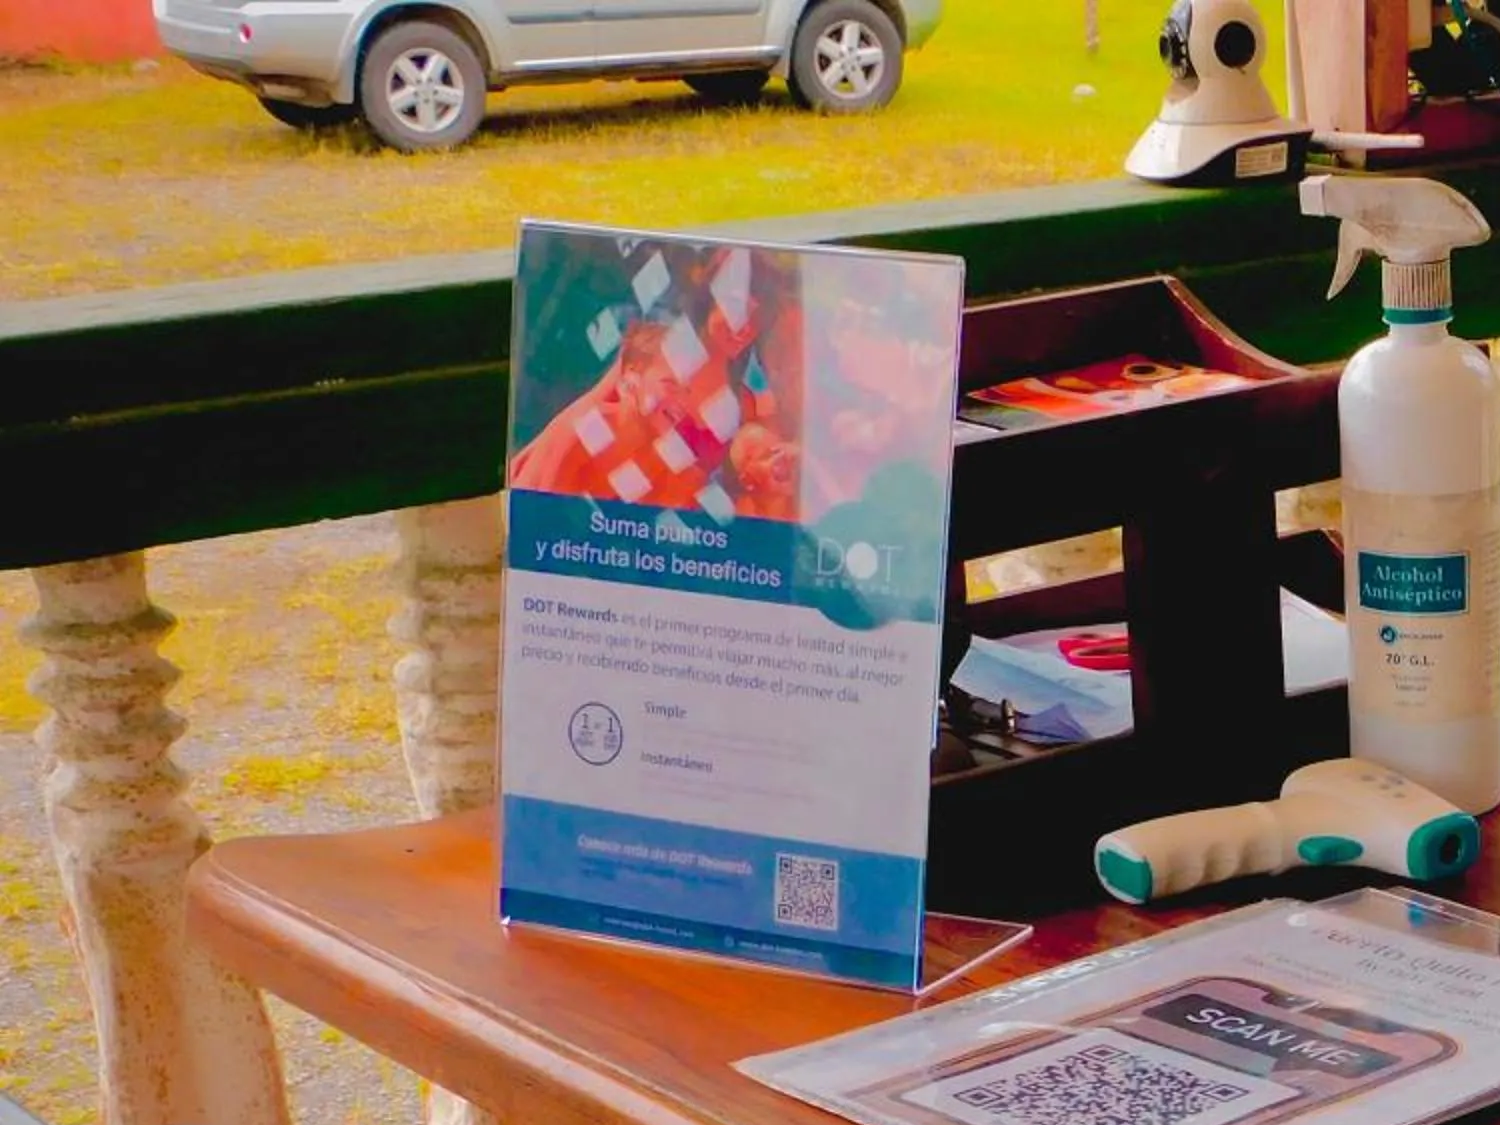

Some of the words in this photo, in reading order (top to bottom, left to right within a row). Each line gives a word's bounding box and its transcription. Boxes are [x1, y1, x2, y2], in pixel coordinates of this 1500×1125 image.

[590, 510, 649, 539] Suma
[655, 522, 728, 549] puntos
[535, 540, 548, 561] y
[551, 539, 630, 568] disfruta
[635, 549, 666, 573] los
[671, 553, 782, 588] beneficios
[1374, 565, 1443, 583] Alcohol
[522, 597, 552, 614] DOT
[557, 602, 619, 625] Rewards
[643, 700, 688, 721] Simple
[1185, 1008, 1297, 1047] SCAN
[1287, 1039, 1361, 1066] ME
